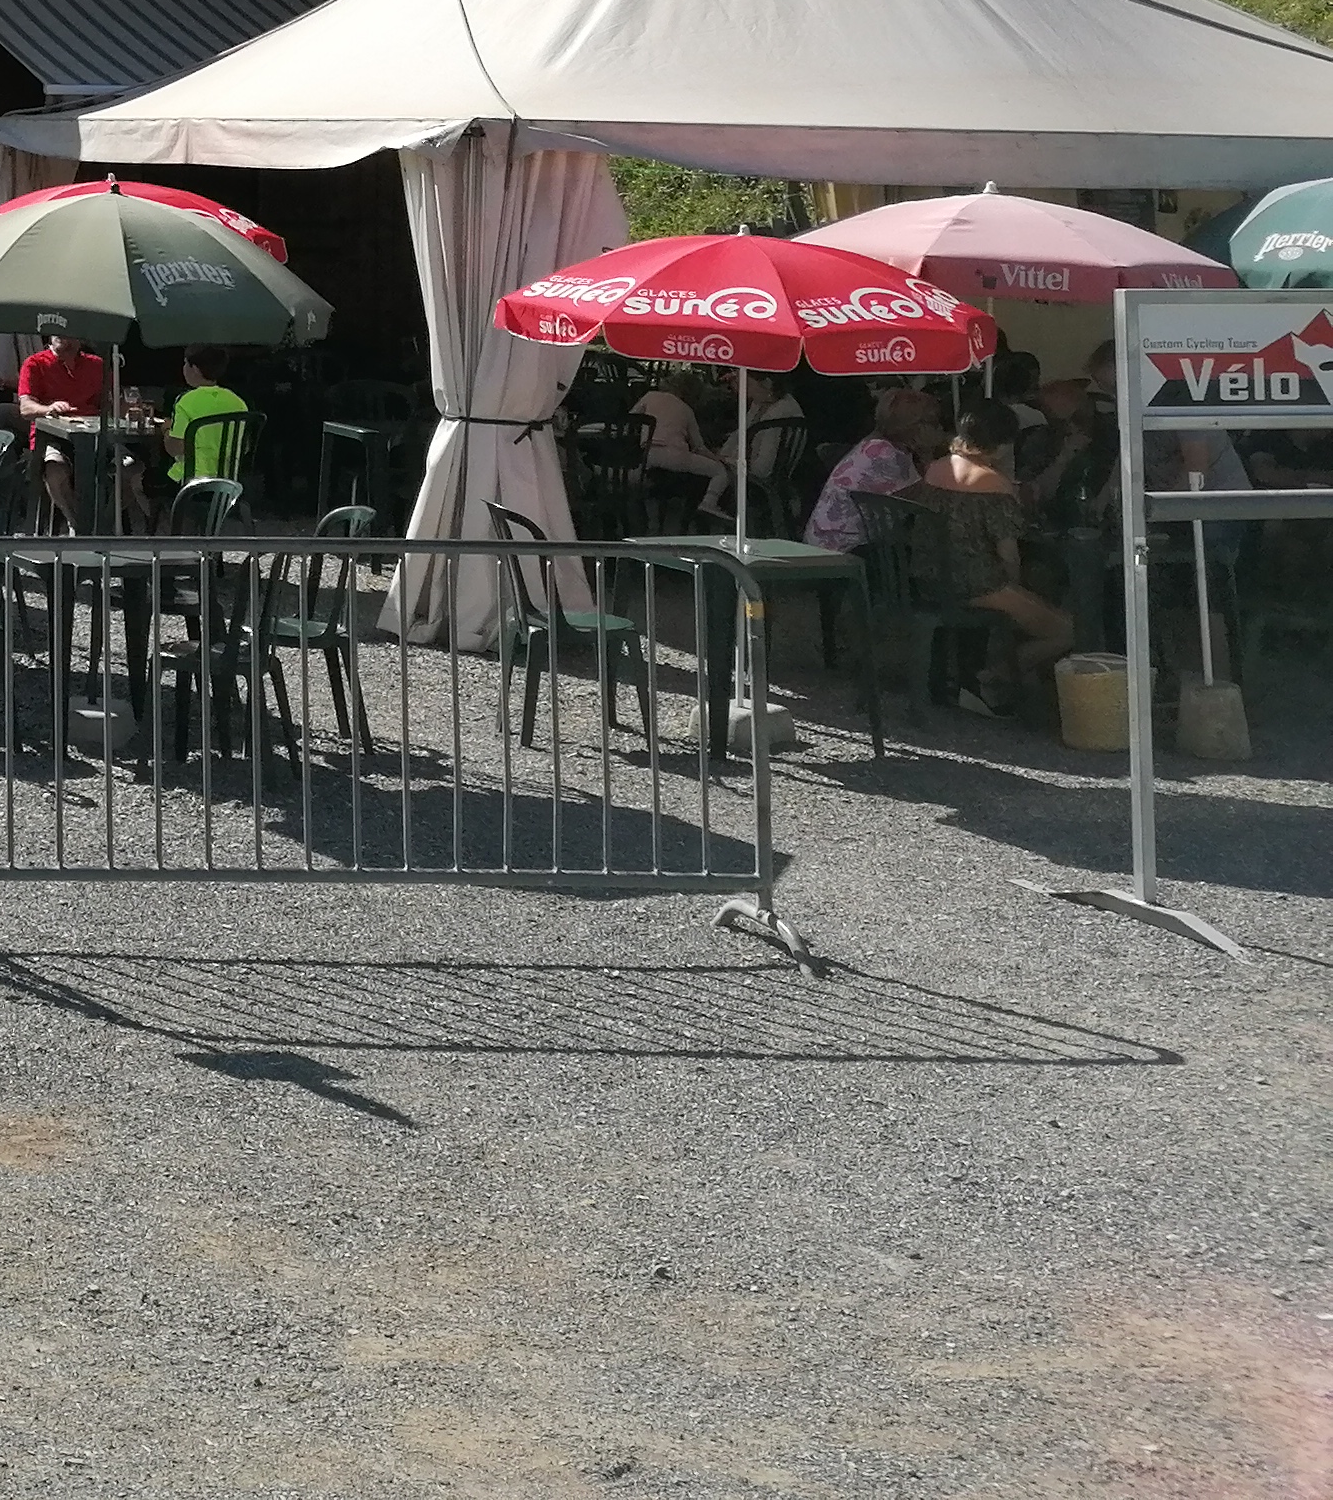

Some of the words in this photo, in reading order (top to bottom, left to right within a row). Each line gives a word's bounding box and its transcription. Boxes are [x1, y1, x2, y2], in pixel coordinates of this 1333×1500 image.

[1000, 263, 1071, 292] Vittel
[637, 289, 697, 299] GLACES
[795, 297, 842, 308] GLACES
[1143, 338, 1183, 349] Custom
[1186, 338, 1225, 350] Cycling
[1227, 338, 1258, 349] Tours
[1179, 357, 1301, 401] Vélo
